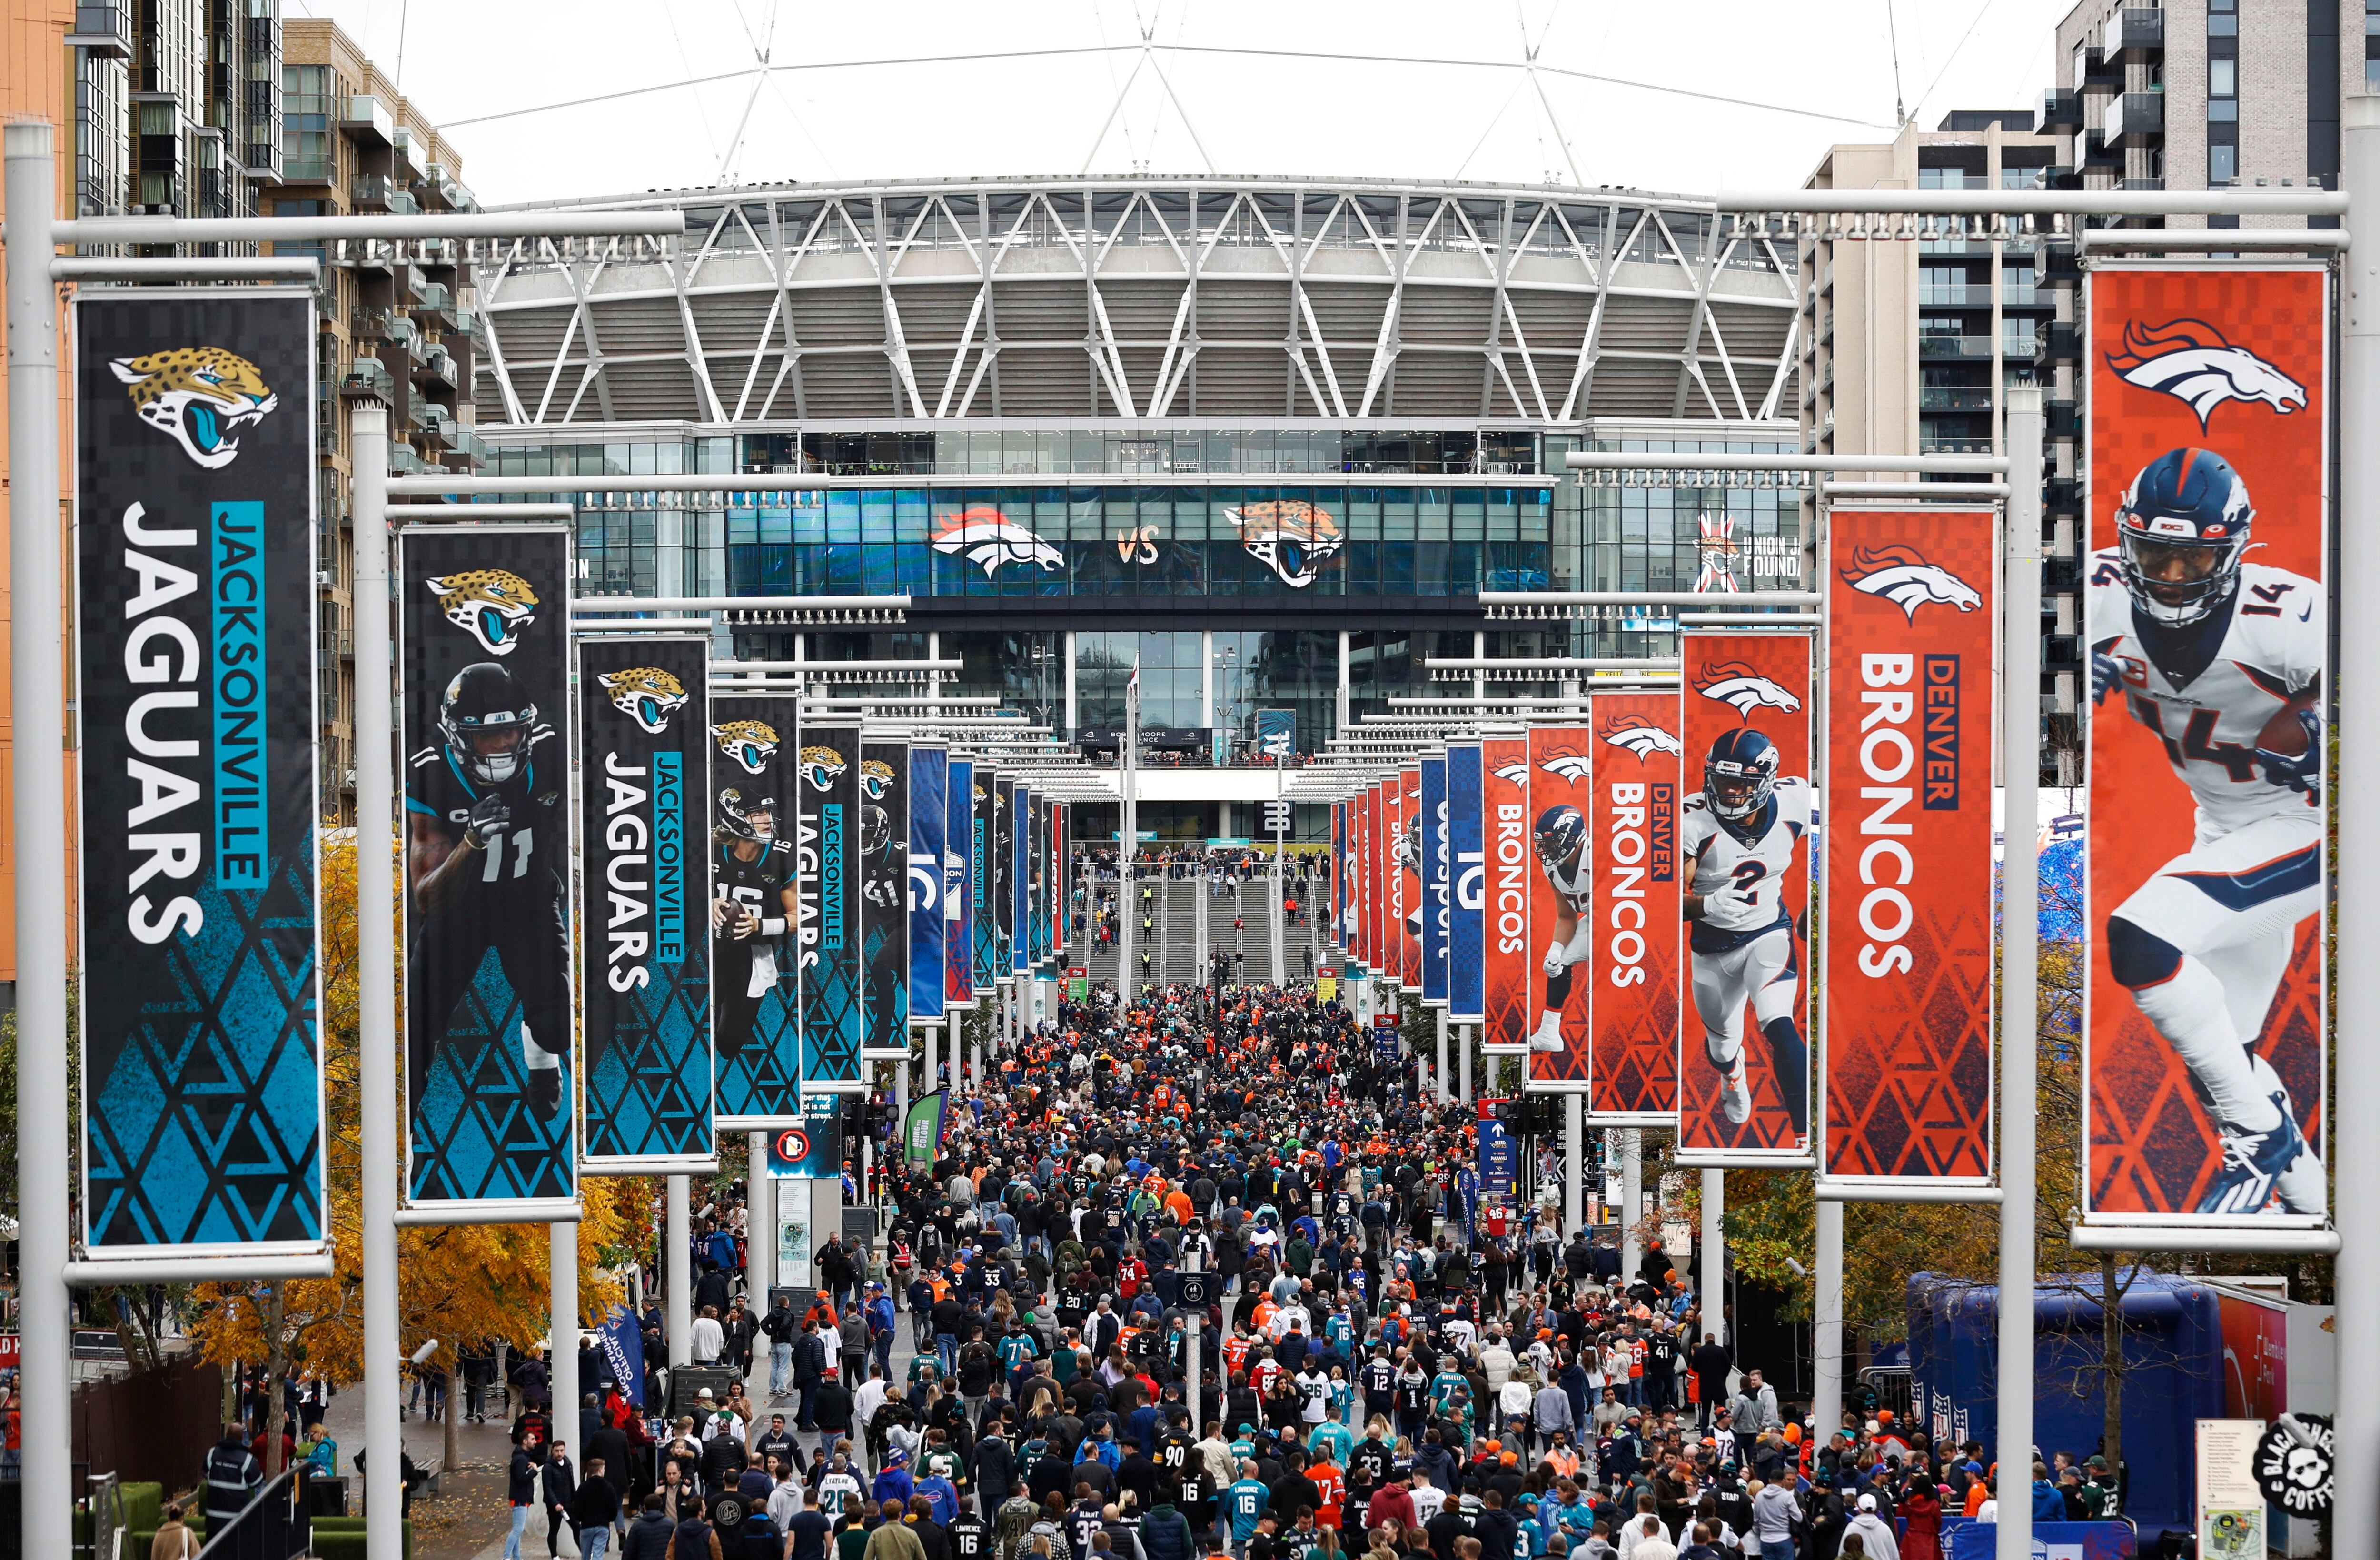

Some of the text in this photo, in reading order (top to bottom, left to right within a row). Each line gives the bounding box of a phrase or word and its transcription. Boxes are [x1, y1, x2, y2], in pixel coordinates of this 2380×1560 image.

[1118, 525, 1159, 566] VS
[1744, 537, 1785, 555] UNION
[2241, 584, 2296, 618] 14
[218, 510, 259, 880] JACKSONVILLE
[123, 500, 204, 944] JAGUARS
[1927, 659, 1955, 803] DENVER
[2133, 695, 2258, 783] 14
[1858, 652, 1914, 978] BRONCOS
[1653, 786, 1672, 878] DENVER
[773, 839, 792, 853] 16
[482, 828, 533, 882] 11
[656, 757, 681, 959] JACKSONVILLE
[975, 820, 983, 907] JACKSONVILLE
[605, 752, 649, 993] JAGUARS
[824, 807, 840, 945] JACKSONVILLE
[1391, 822, 1401, 919] BRONCOS
[1497, 804, 1524, 954] BRONCOS
[1610, 782, 1646, 988] BRONCOS
[1731, 861, 1766, 906] 2
[863, 880, 900, 907] 41
[1346, 1071, 1352, 1079] 12
[919, 1119, 930, 1148] COLOUR
[1455, 1151, 1461, 1160] 18
[1303, 1172, 1309, 1182] 8
[1365, 1174, 1378, 1184] 93
[1438, 1172, 1448, 1183] 85
[1153, 1184, 1158, 1192] 2
[1107, 1215, 1120, 1227] 30
[1488, 1207, 1503, 1219] 46
[1148, 1221, 1155, 1232] 3
[1343, 1222, 1349, 1234] 3
[697, 1242, 709, 1255] 54
[955, 1274, 962, 1285] 3
[985, 1274, 1000, 1286] 33
[1121, 1268, 1135, 1281] 74
[1352, 1278, 1364, 1289] 95
[1066, 1296, 1080, 1308] 20
[1266, 1311, 1279, 1327] 7
[823, 1335, 829, 1348] 1
[1339, 1328, 1349, 1341] 16
[1656, 1346, 1668, 1359] 41
[1305, 1384, 1322, 1398] 26
[1373, 1375, 1388, 1391] 12
[1409, 1390, 1418, 1408] 1
[1719, 1439, 1735, 1456] 72
[1166, 1446, 1185, 1467] 90
[1182, 1483, 1198, 1501] 16
[1721, 1492, 1739, 1502] STAFF
[1239, 1496, 1256, 1514] 16
[1421, 1505, 1437, 1520] 17
[2102, 1494, 2119, 1517] 12
[955, 1525, 981, 1533] LAWRENCE
[1009, 1518, 1027, 1538] 41
[959, 1535, 978, 1554] 16
